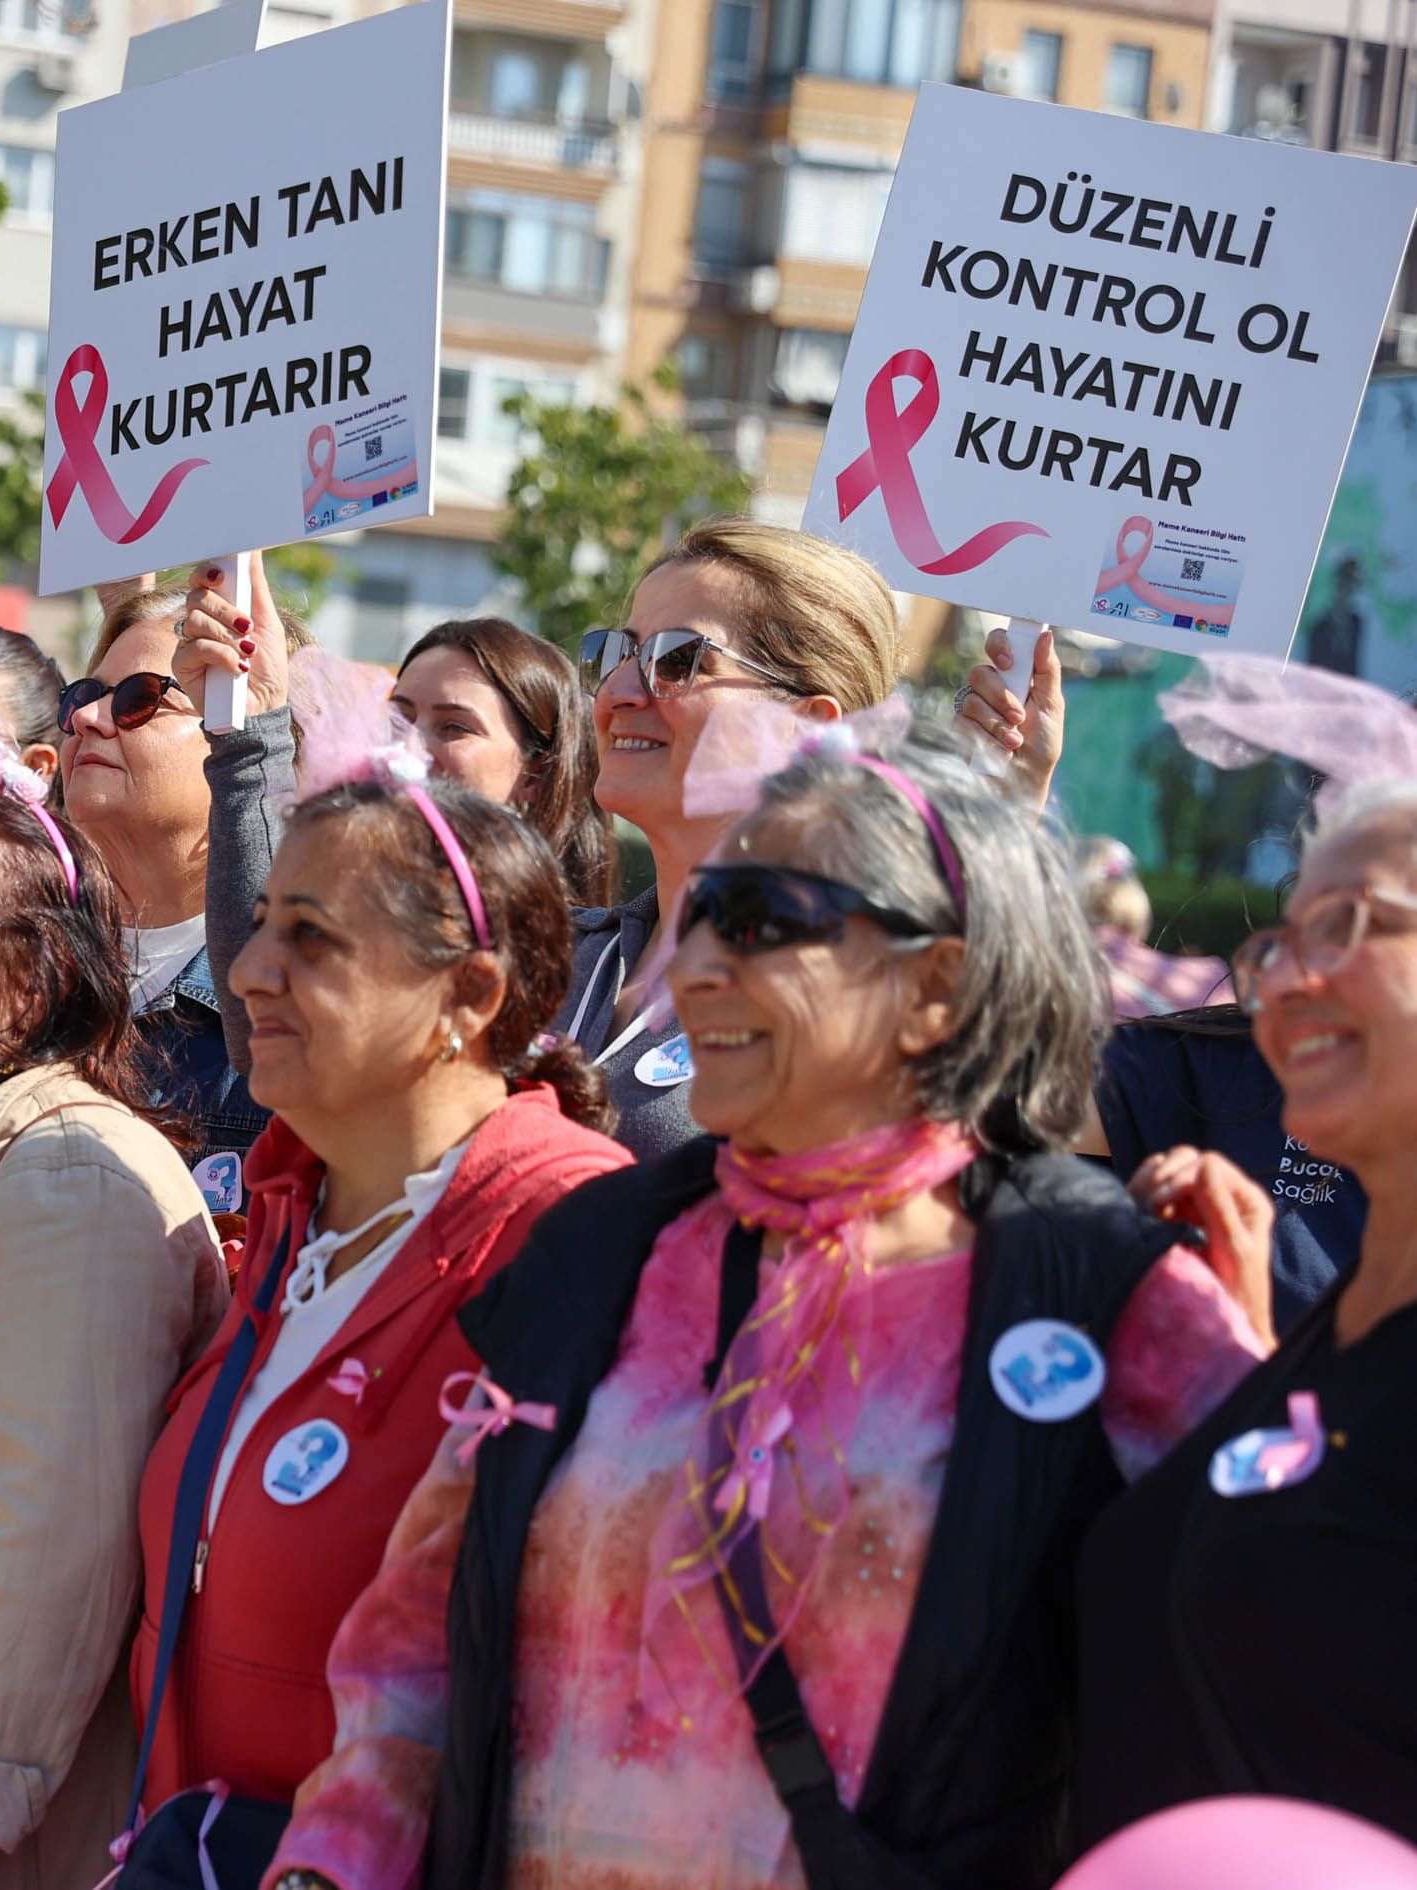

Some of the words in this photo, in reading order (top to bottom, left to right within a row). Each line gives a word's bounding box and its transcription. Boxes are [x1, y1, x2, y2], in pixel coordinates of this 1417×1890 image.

[94, 196, 260, 291] ERKEN
[278, 156, 404, 238] TANI
[1000, 171, 1276, 268] DÜZENLİ
[159, 265, 326, 358] HAYAT
[921, 240, 1215, 344] KONTROL
[1237, 303, 1319, 363] OL
[111, 345, 371, 455] KURTARIR
[959, 330, 1242, 430] HAYATINI
[955, 411, 1202, 506] KURTAR
[1272, 1179, 1336, 1206] Sağlık
